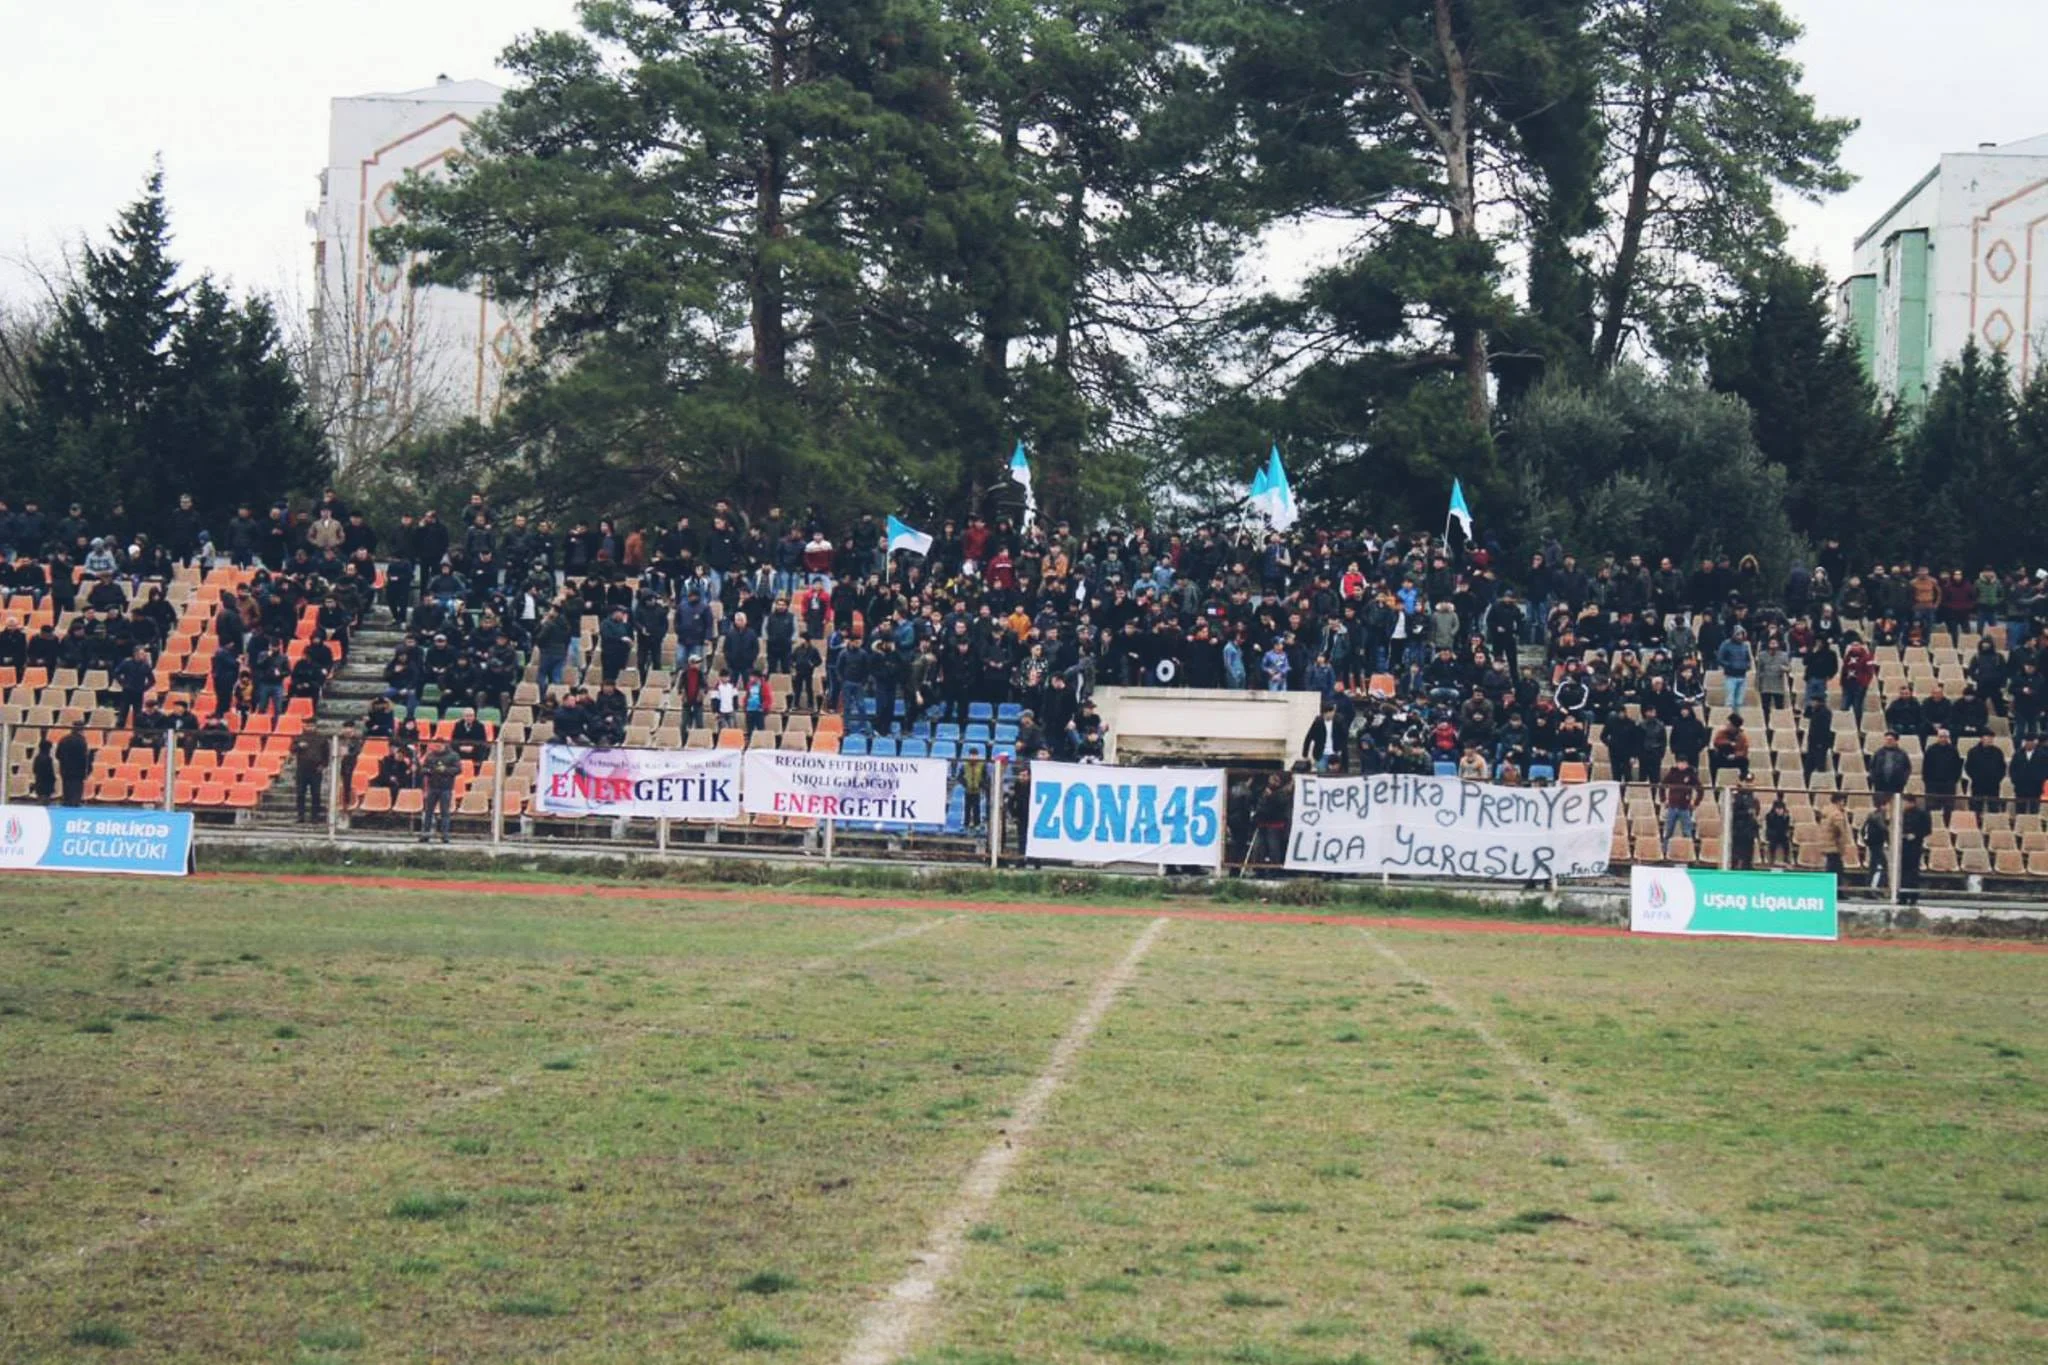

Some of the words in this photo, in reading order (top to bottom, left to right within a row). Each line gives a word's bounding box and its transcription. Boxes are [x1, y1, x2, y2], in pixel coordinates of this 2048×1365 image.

[550, 772, 731, 803] ENERGETİK
[773, 791, 918, 820] ENERGETİK
[1033, 781, 1217, 847] ZONA45
[66, 819, 91, 834] BİZ
[95, 820, 168, 838] BİRLİKDƏ
[63, 838, 167, 860] GÜCLÜYÜK!
[1703, 893, 1748, 910] UŞAQ
[1751, 893, 1824, 912] LİQALARI
